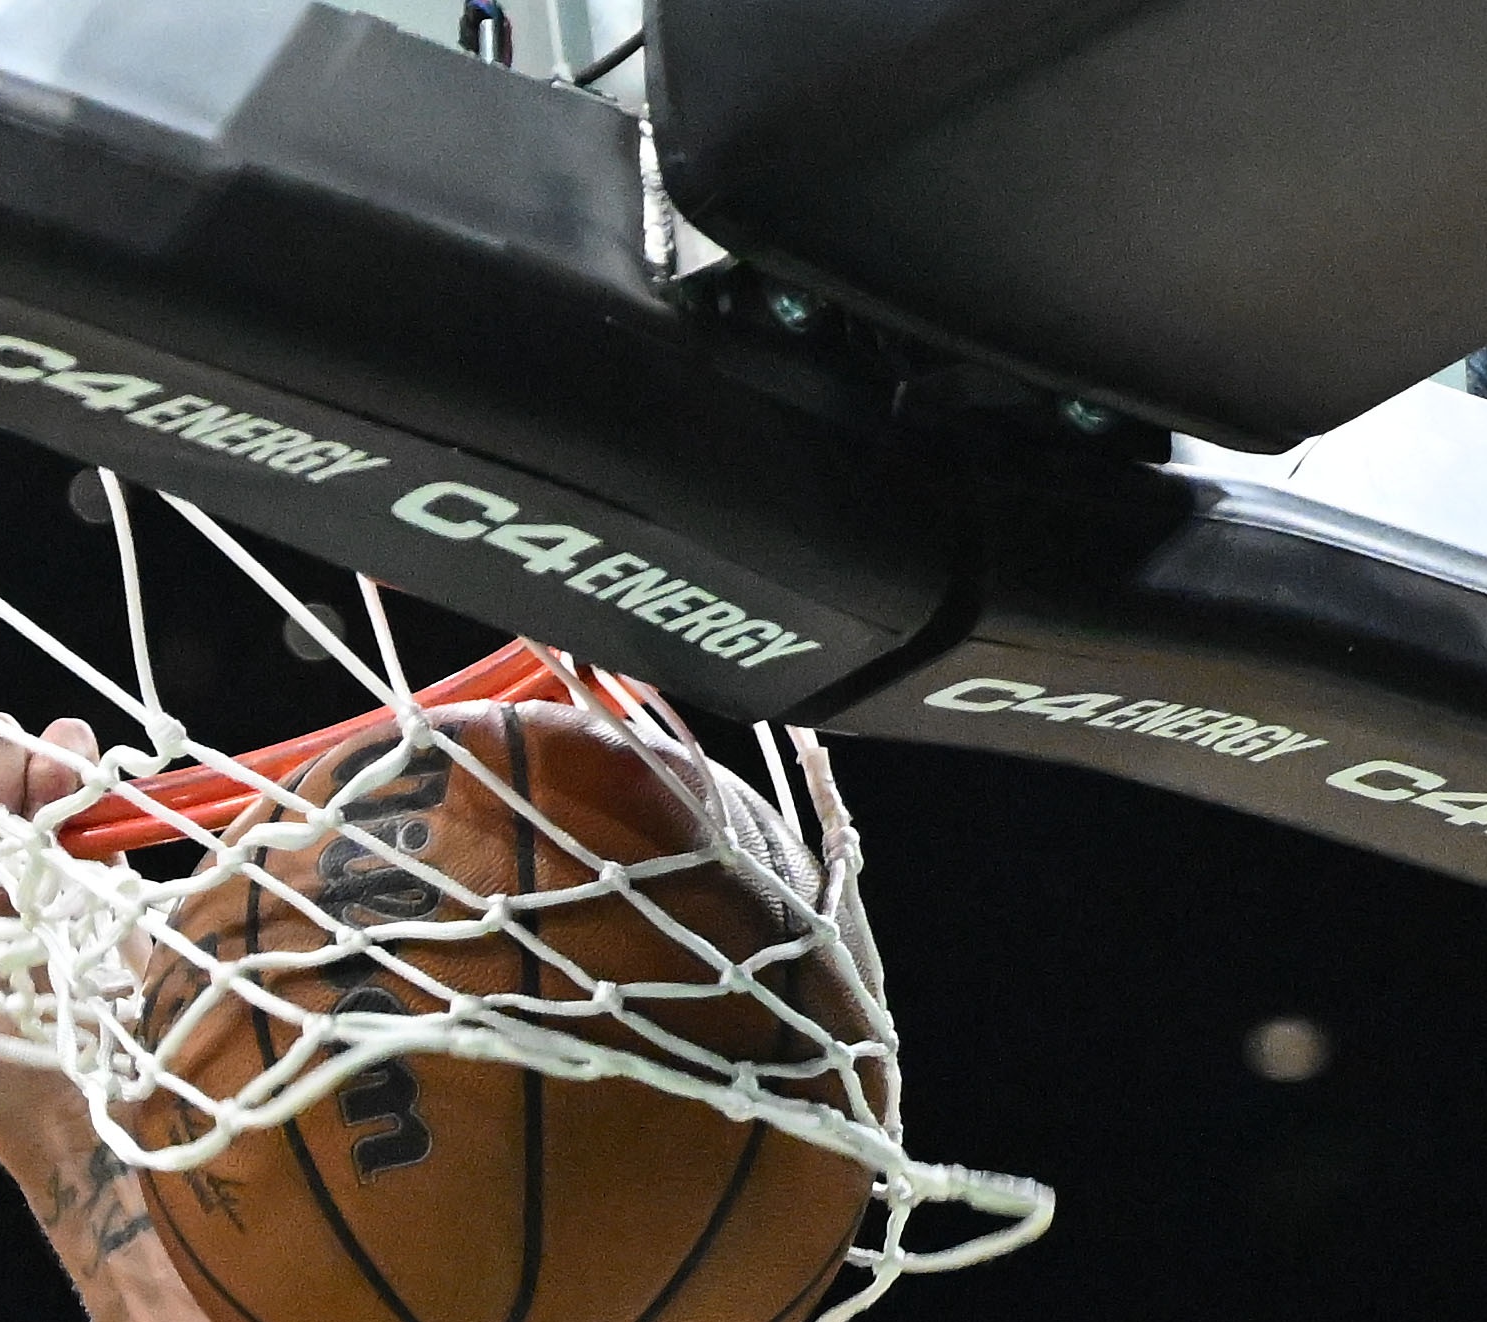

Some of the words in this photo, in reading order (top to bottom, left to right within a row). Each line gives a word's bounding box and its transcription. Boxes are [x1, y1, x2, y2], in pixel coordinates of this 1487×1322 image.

[127, 394, 391, 482] ENERGY
[391, 481, 604, 574] C4
[564, 552, 823, 668] ENERGY
[923, 677, 1123, 722] C4
[1088, 700, 1329, 762] ENERGY
